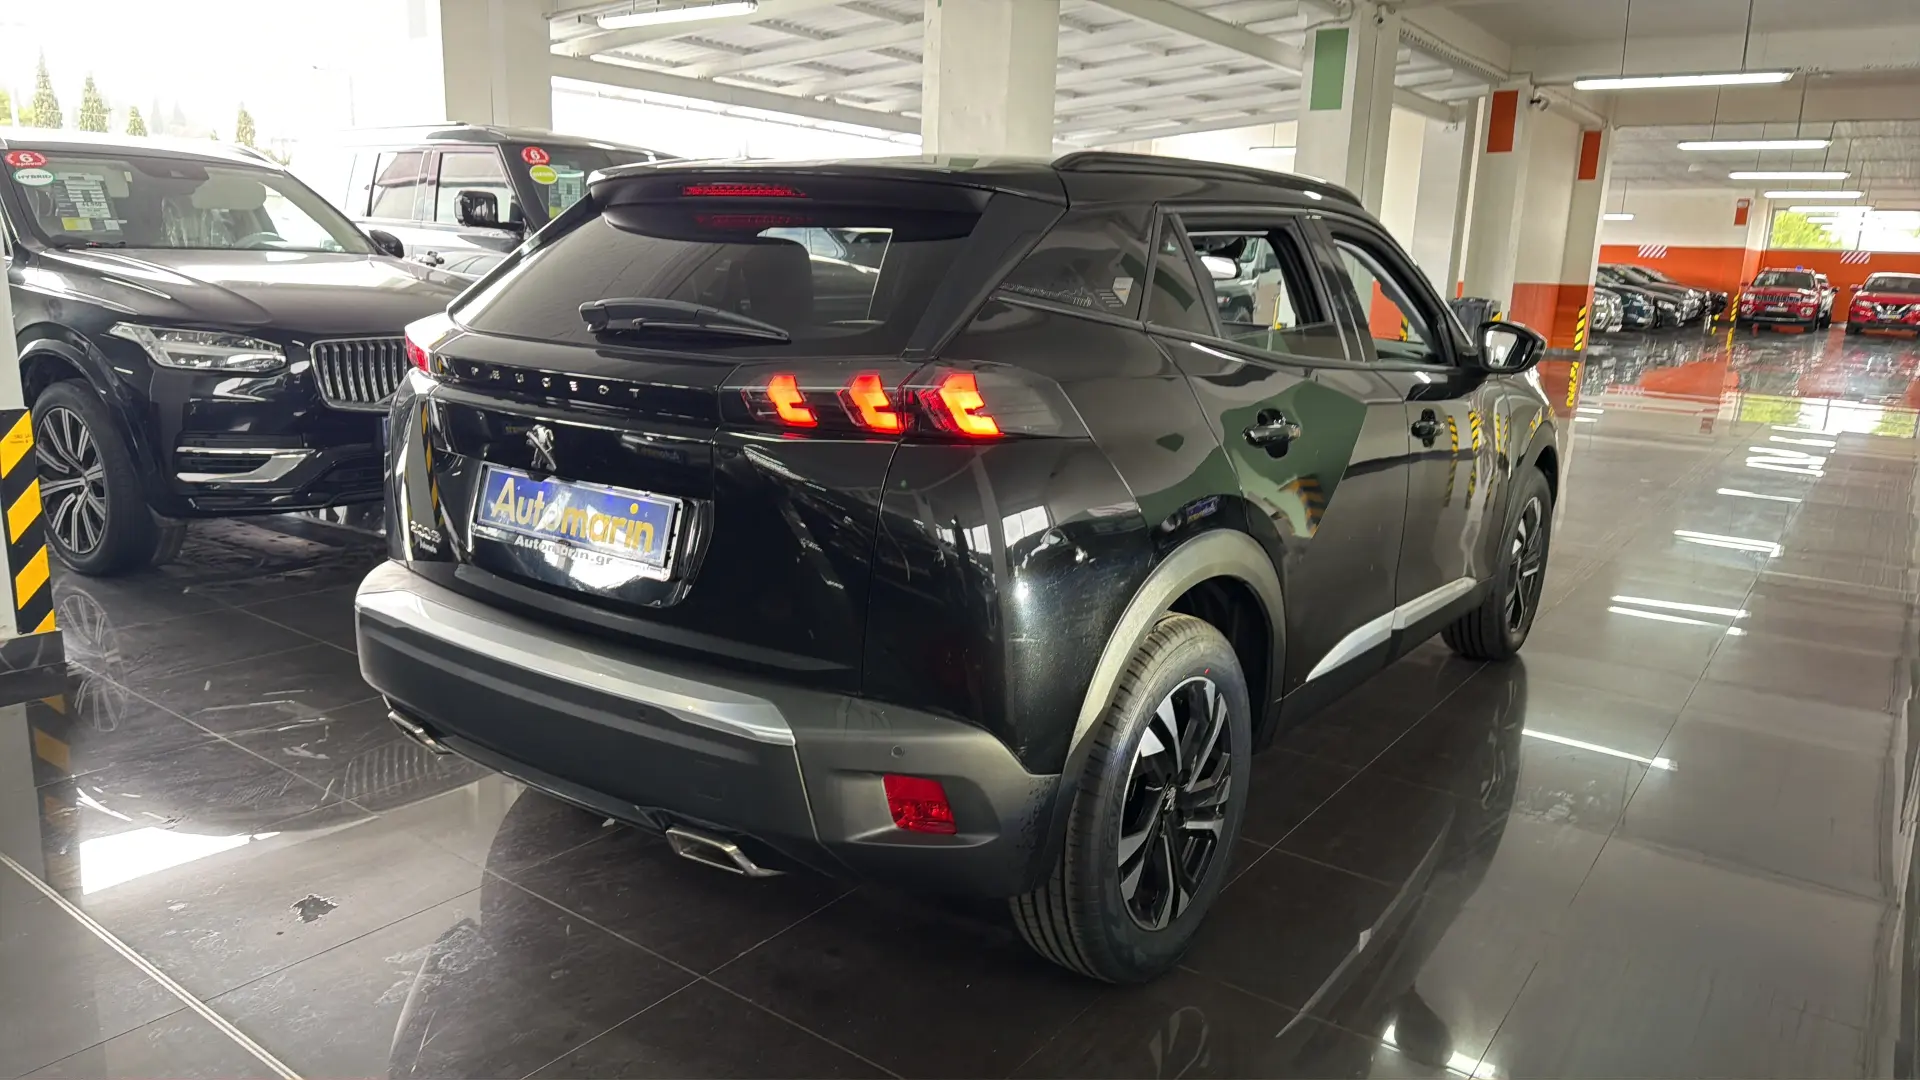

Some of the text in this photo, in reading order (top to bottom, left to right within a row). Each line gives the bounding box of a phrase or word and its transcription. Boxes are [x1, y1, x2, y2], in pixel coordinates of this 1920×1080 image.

[19, 153, 34, 163] 6
[530, 150, 541, 160] 6
[470, 366, 640, 400] PEUGEOT
[491, 477, 655, 554] Automarin
[410, 520, 442, 543] 2008
[514, 535, 613, 566] Automarin.gr
